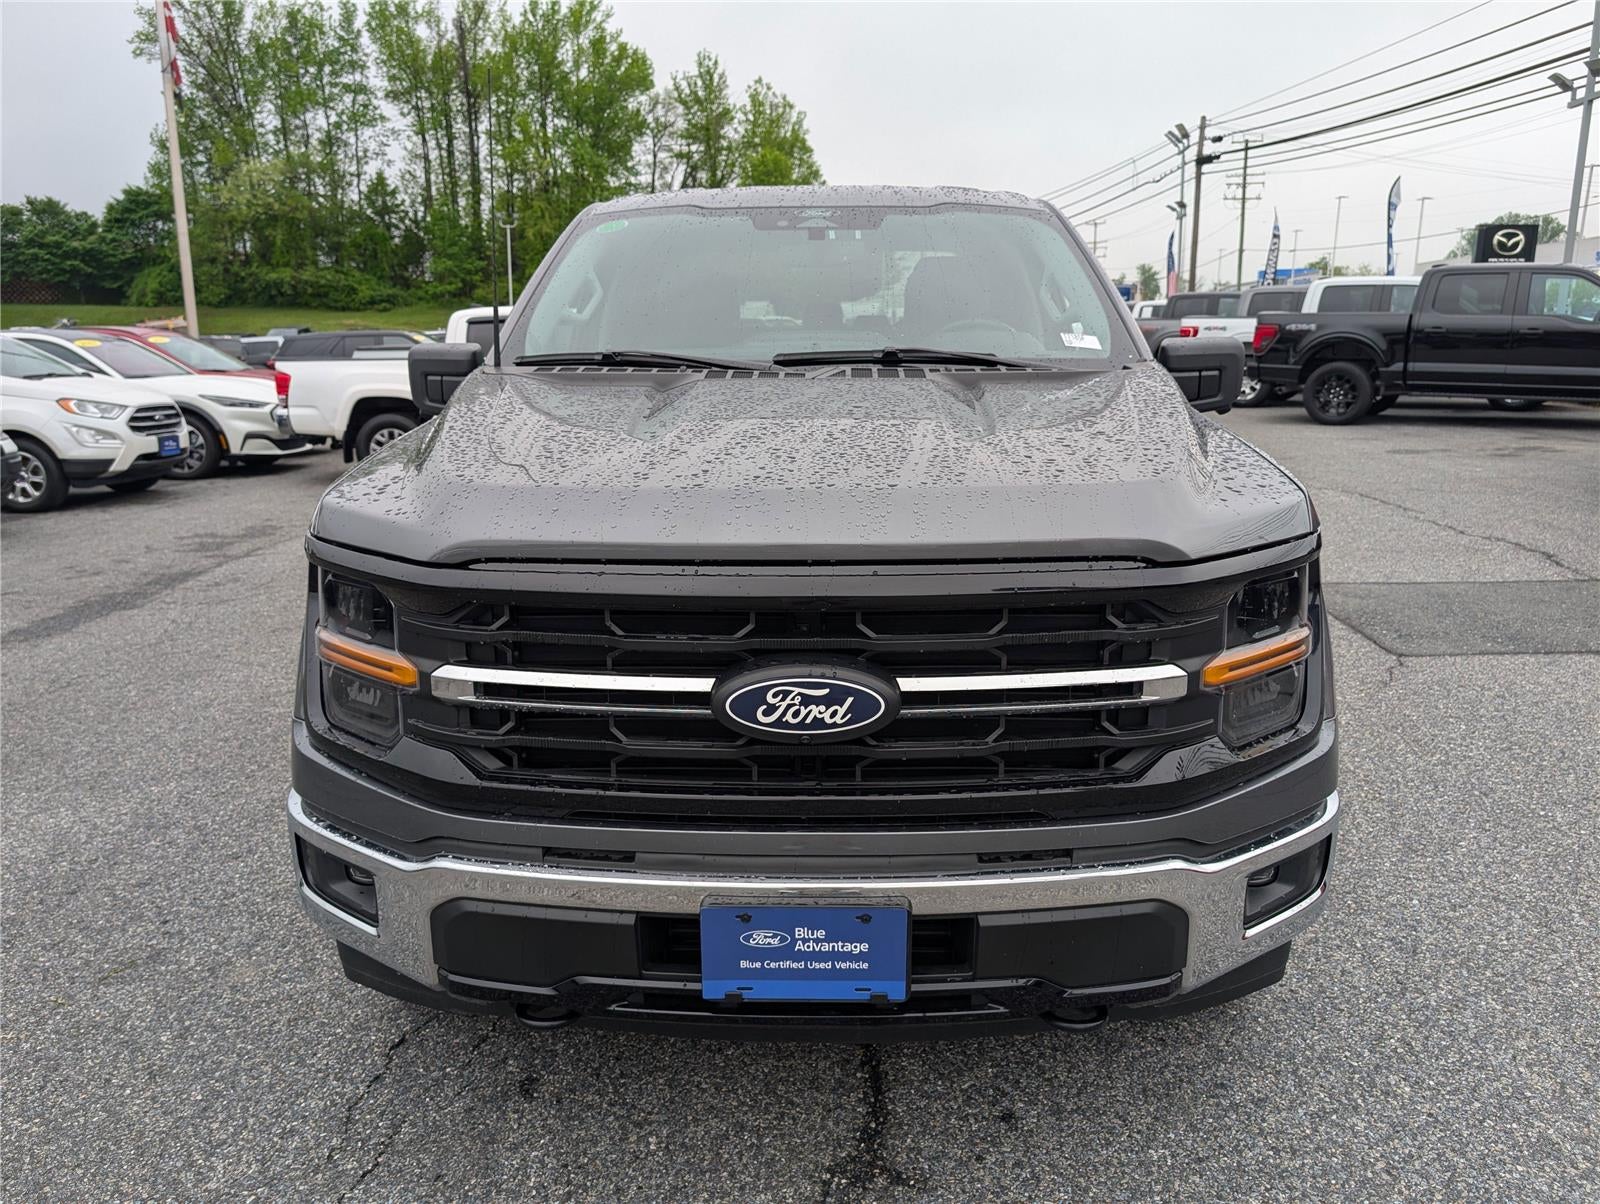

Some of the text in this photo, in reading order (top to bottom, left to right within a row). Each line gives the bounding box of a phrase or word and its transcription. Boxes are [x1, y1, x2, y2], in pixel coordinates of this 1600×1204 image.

[756, 686, 854, 725] Ford
[749, 932, 781, 945] Ford
[794, 927, 826, 939] Blue
[794, 940, 869, 954] Advantage
[740, 960, 869, 969] Blue Certified Used Vehicle
